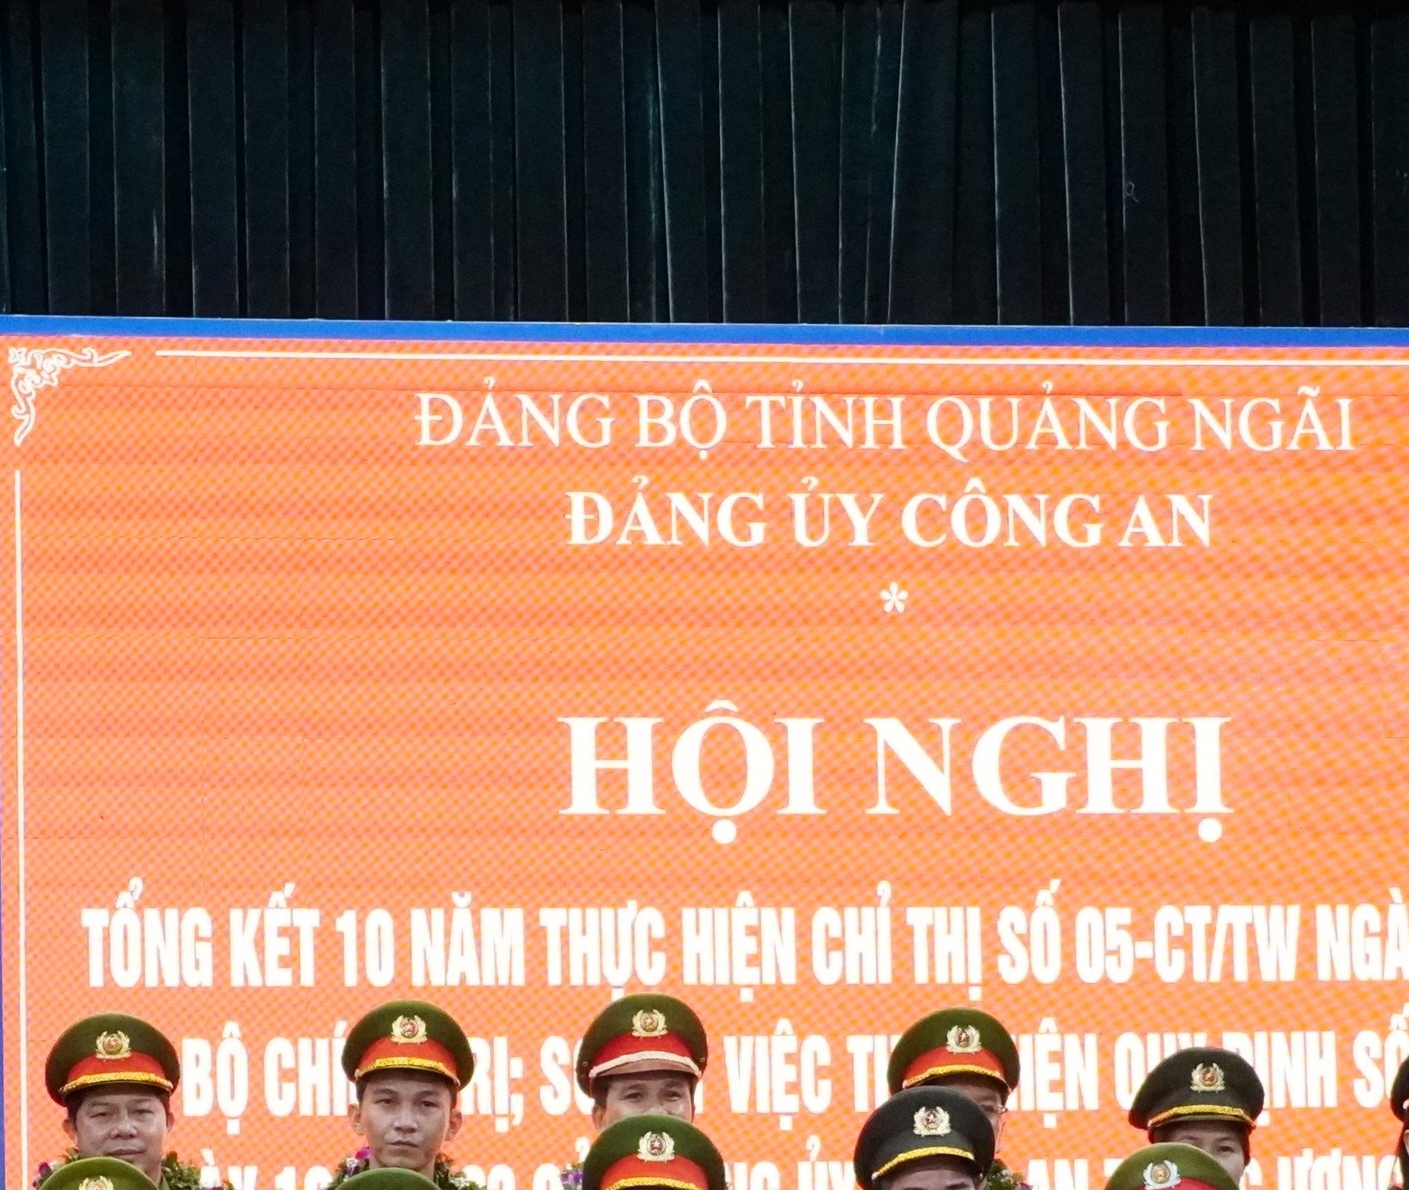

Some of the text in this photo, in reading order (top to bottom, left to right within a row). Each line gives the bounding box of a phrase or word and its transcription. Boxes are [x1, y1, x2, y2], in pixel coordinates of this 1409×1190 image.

[415, 377, 1354, 462] ĐẢNG BỘ TỈNH QUẢNG NGÃI
[567, 475, 1212, 548] ĐẢNG ỦY CÔNG AN
[558, 699, 1233, 845] HỘI NGHỊ
[80, 877, 214, 988] TỔNG
[229, 882, 321, 988] KẾT
[335, 908, 395, 987] 10
[410, 891, 526, 987] NĂM
[538, 899, 667, 999] THỰC
[681, 890, 797, 1003] HIỆN
[811, 880, 893, 985] CHỈ
[905, 906, 983, 1001] THỊ
[996, 879, 1062, 985] SỐ
[1074, 904, 1301, 984] 05-CT/TW
[181, 1020, 249, 1136] BỘ
[264, 1020, 360, 1117] CHÍ
[723, 1018, 831, 1131] VIỆC
